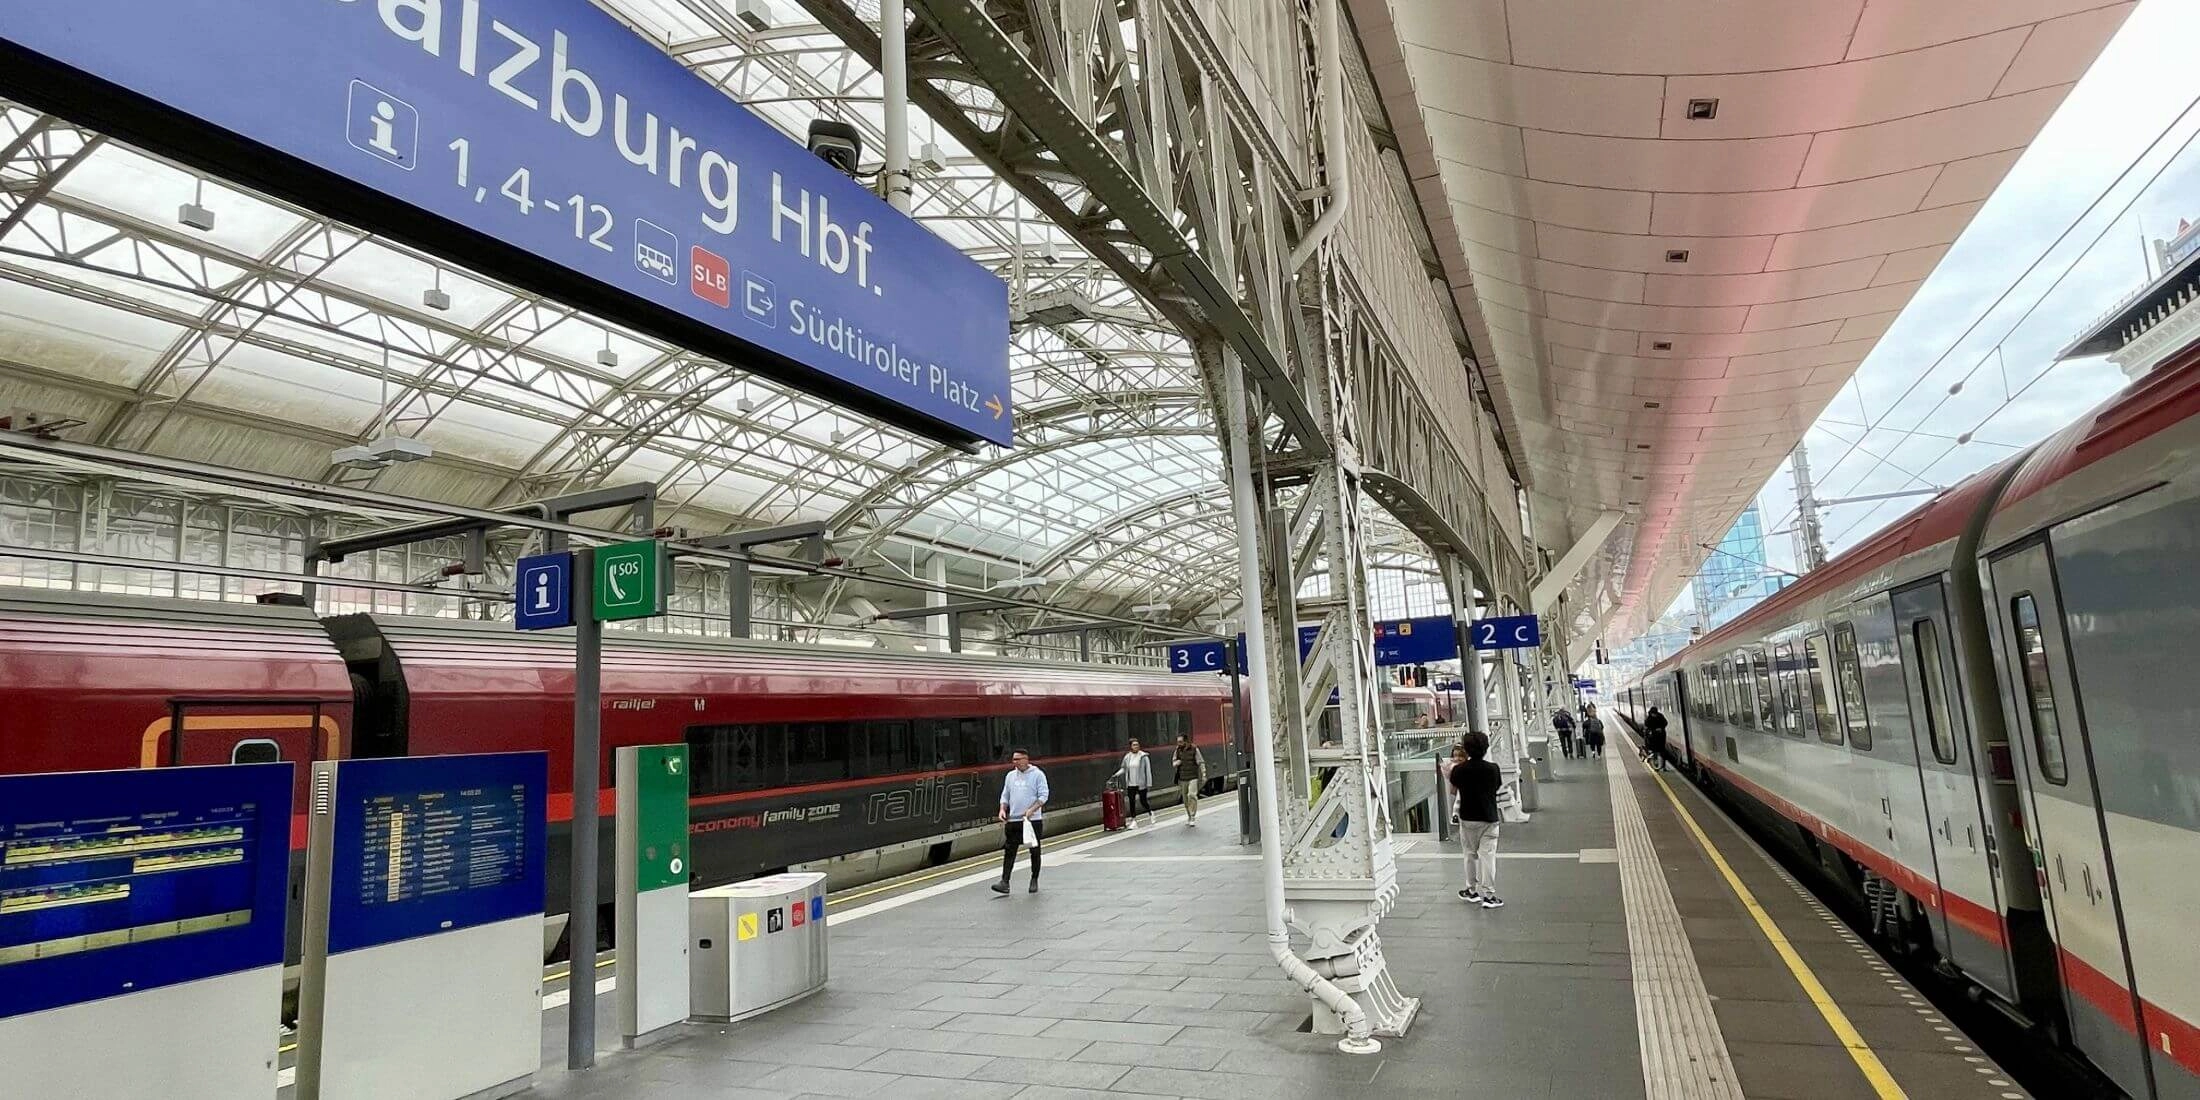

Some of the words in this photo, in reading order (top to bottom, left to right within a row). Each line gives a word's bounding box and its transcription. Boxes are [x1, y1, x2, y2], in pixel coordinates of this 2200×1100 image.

[336, 0, 740, 235] alzburg
[770, 170, 882, 297] Hbf.
[448, 137, 487, 204] 1,
[693, 263, 728, 292] SLB
[789, 298, 922, 387] Südtiroler
[929, 363, 981, 414] Platz
[619, 561, 639, 577] SOS
[1481, 623, 1497, 645] 2
[1177, 649, 1190, 668] 3
[612, 698, 657, 711] railjet
[867, 771, 982, 825] railjet
[688, 813, 762, 835] economy
[762, 806, 806, 827] family
[807, 802, 841, 817] zone
